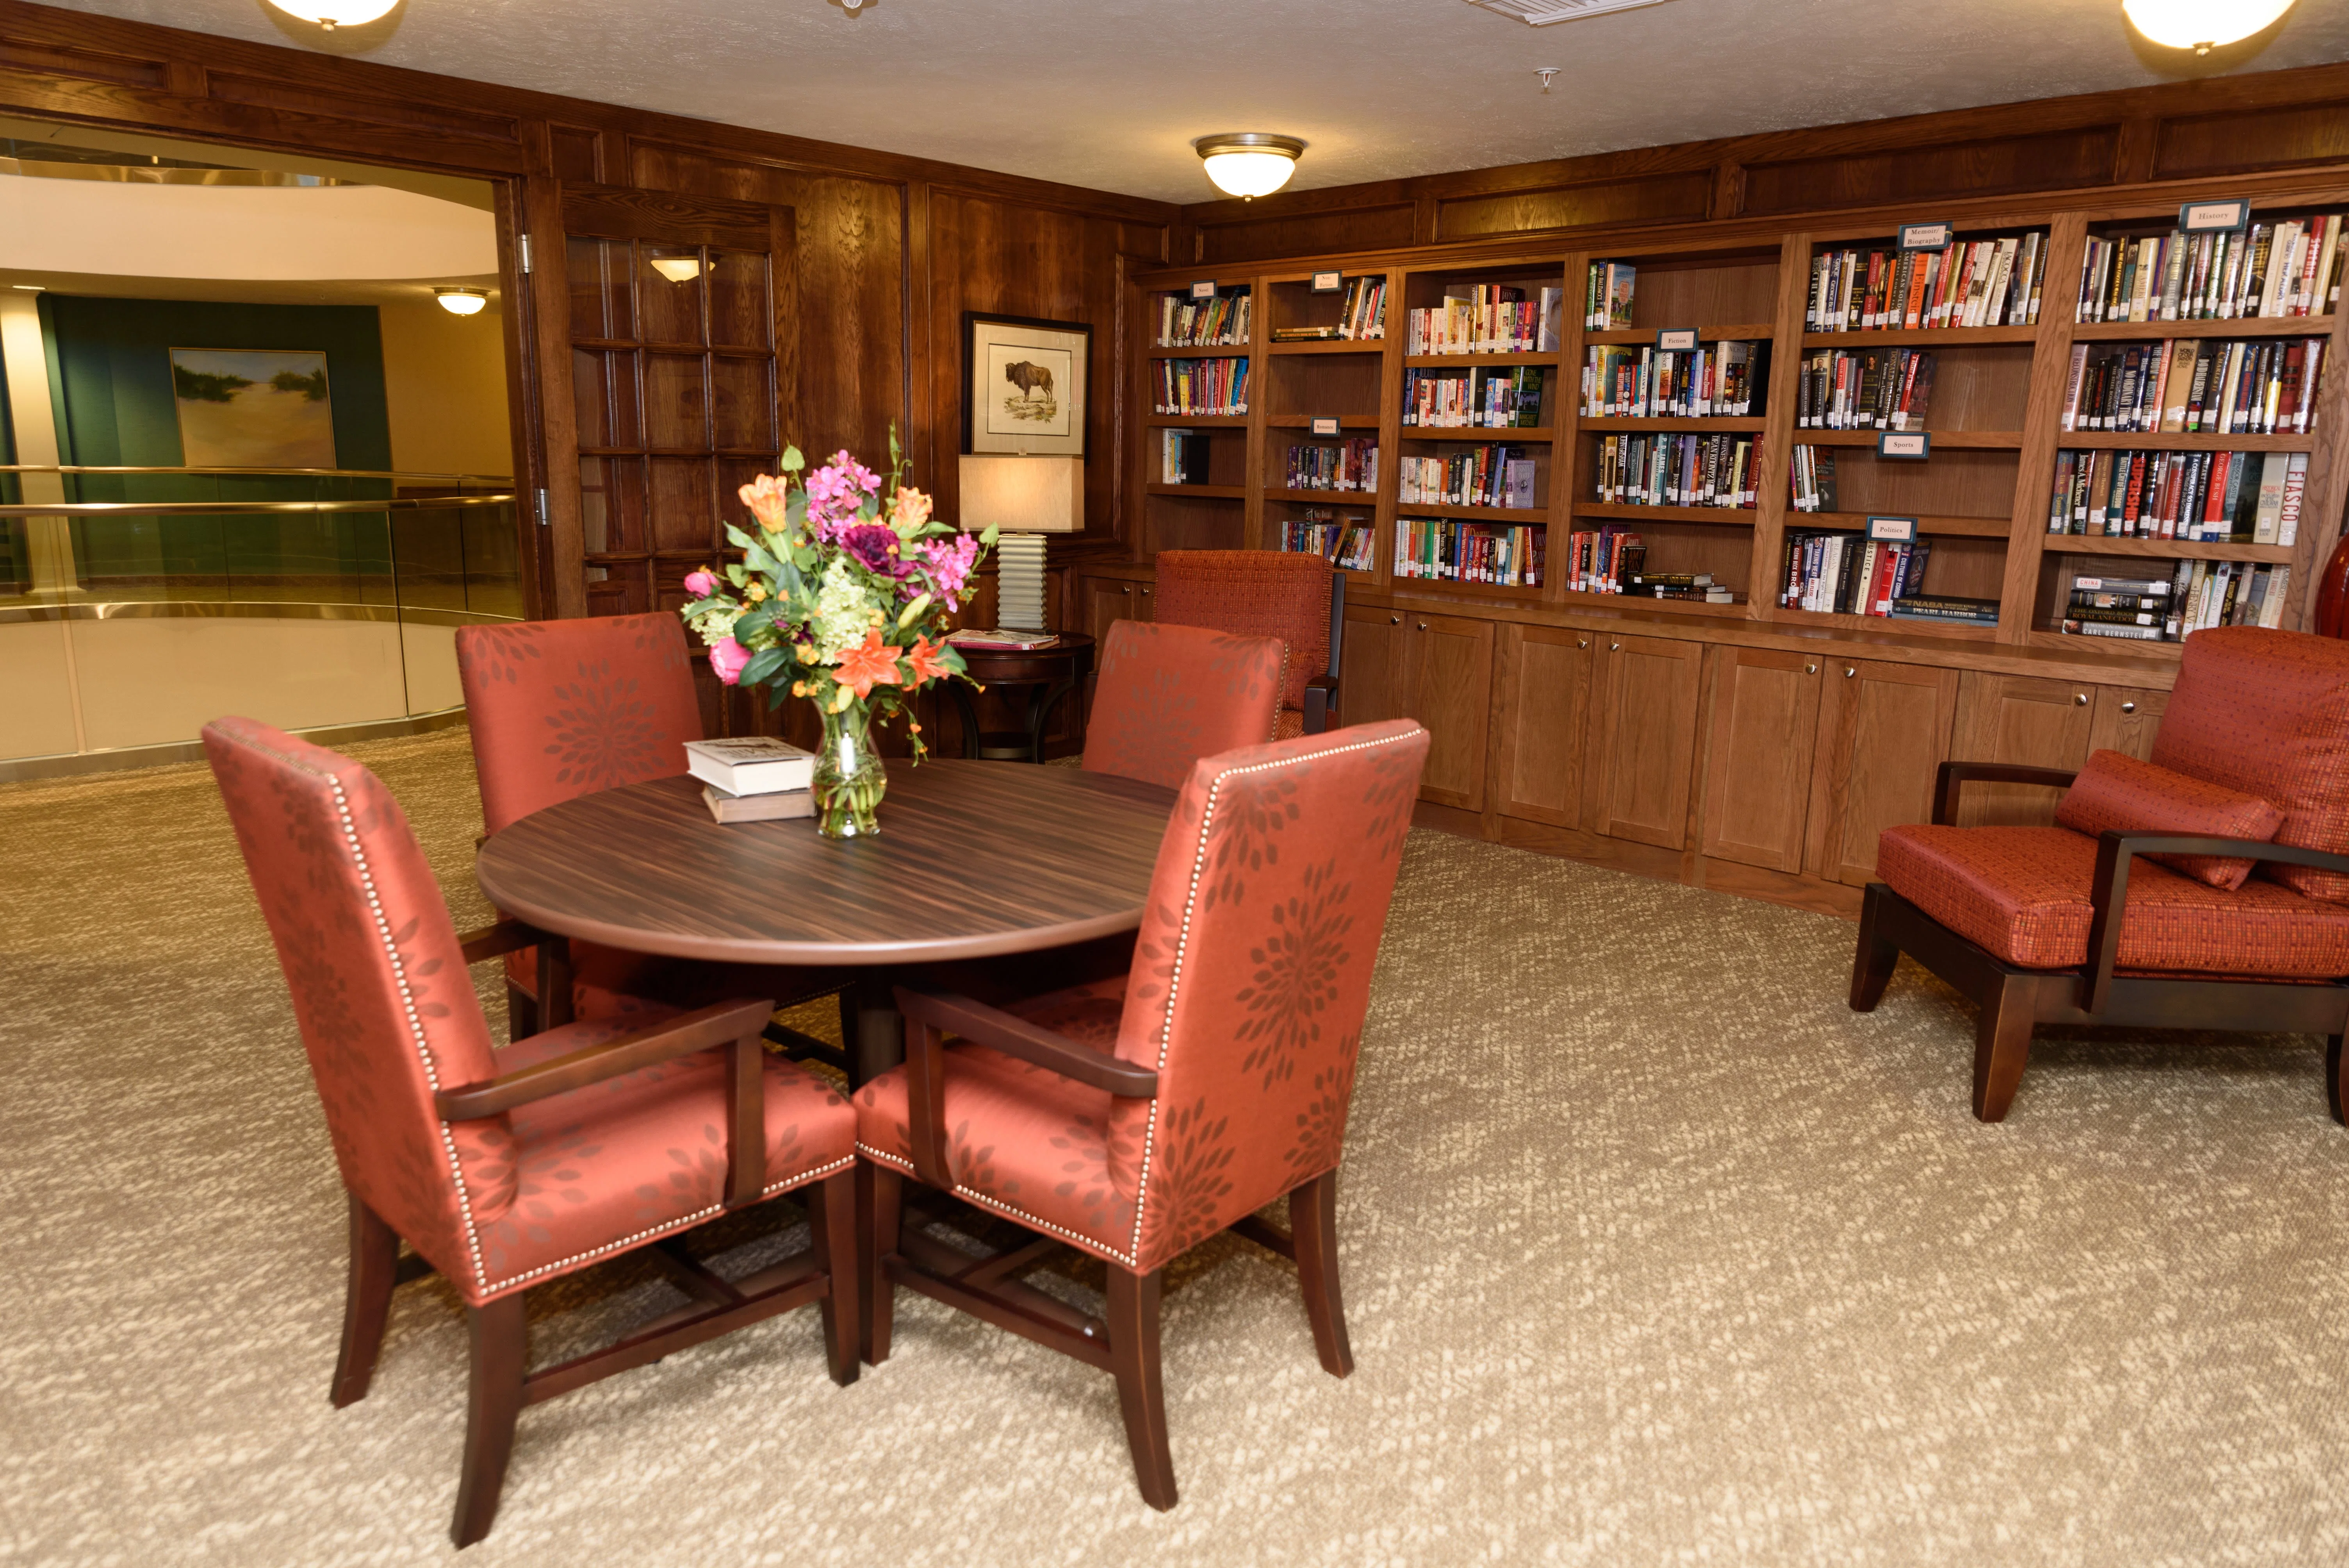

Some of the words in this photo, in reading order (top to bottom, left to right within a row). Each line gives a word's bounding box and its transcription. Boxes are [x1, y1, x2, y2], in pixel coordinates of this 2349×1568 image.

[1999, 251, 2013, 284] IACOCCA
[2305, 239, 2321, 275] SPUTNIK
[1900, 251, 1910, 288] AMERICAN
[1502, 291, 1516, 301] JAYNE
[1811, 272, 1819, 298] CHILD
[1662, 353, 1670, 368] Nelson
[2153, 347, 2163, 356] THE
[1888, 351, 1897, 381] DONALD
[2150, 358, 2161, 374] BOOM
[2197, 359, 2209, 372] DAVID
[2214, 351, 2226, 384] CHARLES
[2067, 358, 2082, 402] RECONSTRUCTION
[2191, 372, 2206, 401] HALBERSTAM
[2121, 379, 2135, 405] ORDINARY
[2145, 381, 2157, 404] RUSSELL
[1710, 436, 1719, 453] DEAN
[1707, 454, 1716, 478] KOONTZ
[2079, 454, 2088, 472] James
[2119, 457, 2128, 473] BATTLE
[2216, 454, 2225, 481] GEORGE
[2188, 463, 2198, 494] CONSPIRACY
[2231, 481, 2239, 499] CASTLE
[2075, 479, 2084, 506] Michener
[2114, 488, 2123, 508] FREEDOM
[2281, 471, 2304, 521] FIASCO
[1628, 550, 1644, 559] AMY
[1628, 561, 1640, 571] TAN
[1898, 558, 1907, 576] CULTURE
[2213, 579, 2224, 615] Strategery
[2227, 581, 2235, 598] TRUMP
[2189, 590, 2199, 615] HENRY
[2105, 629, 2146, 639] BERNSTEIN
